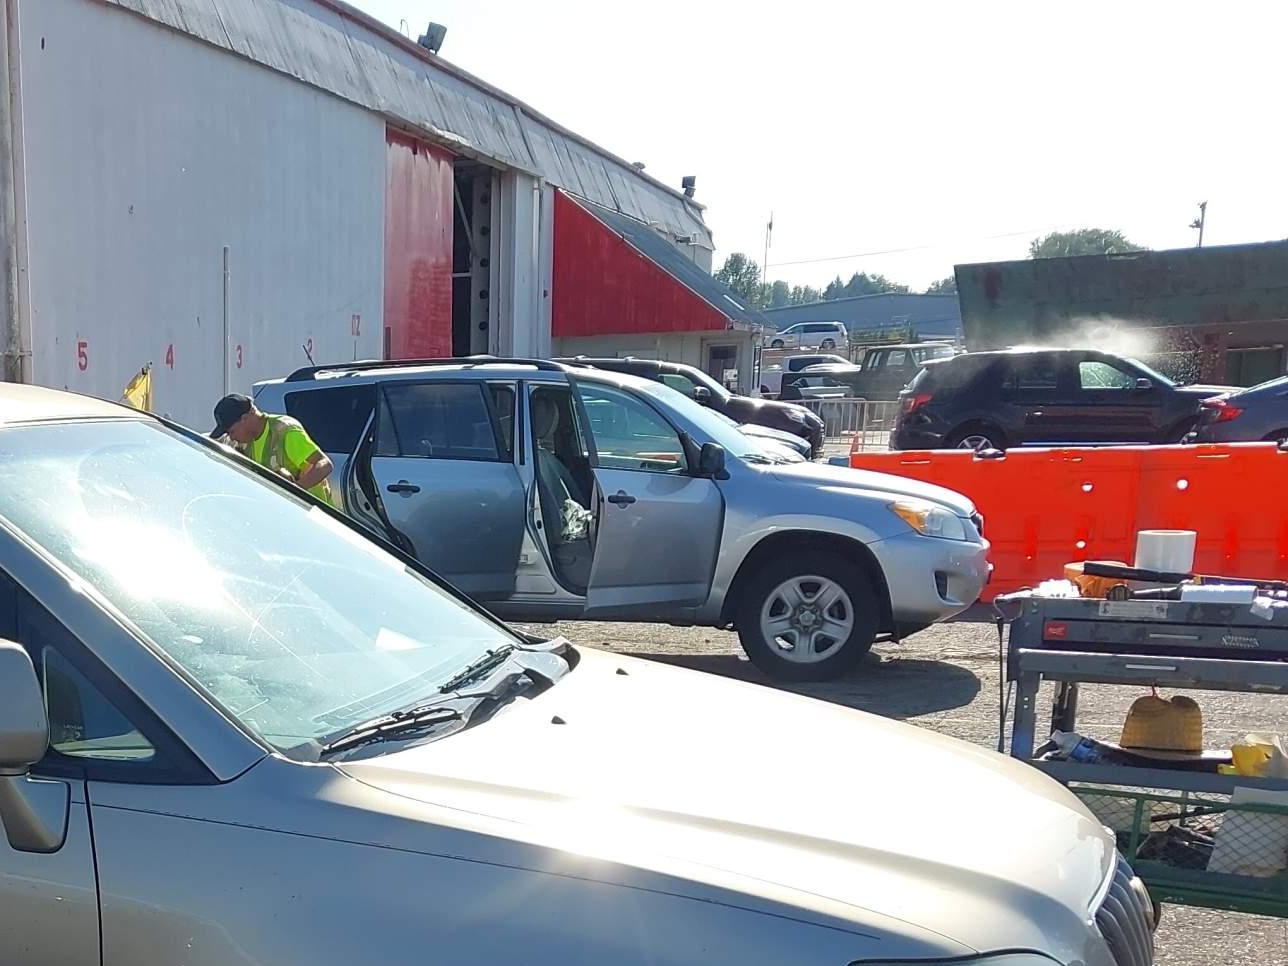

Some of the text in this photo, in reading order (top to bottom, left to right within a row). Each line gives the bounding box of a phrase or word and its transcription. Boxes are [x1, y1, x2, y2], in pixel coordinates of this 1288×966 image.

[76, 341, 89, 371] 5
[165, 344, 176, 370] 4
[235, 344, 244, 369] 3
